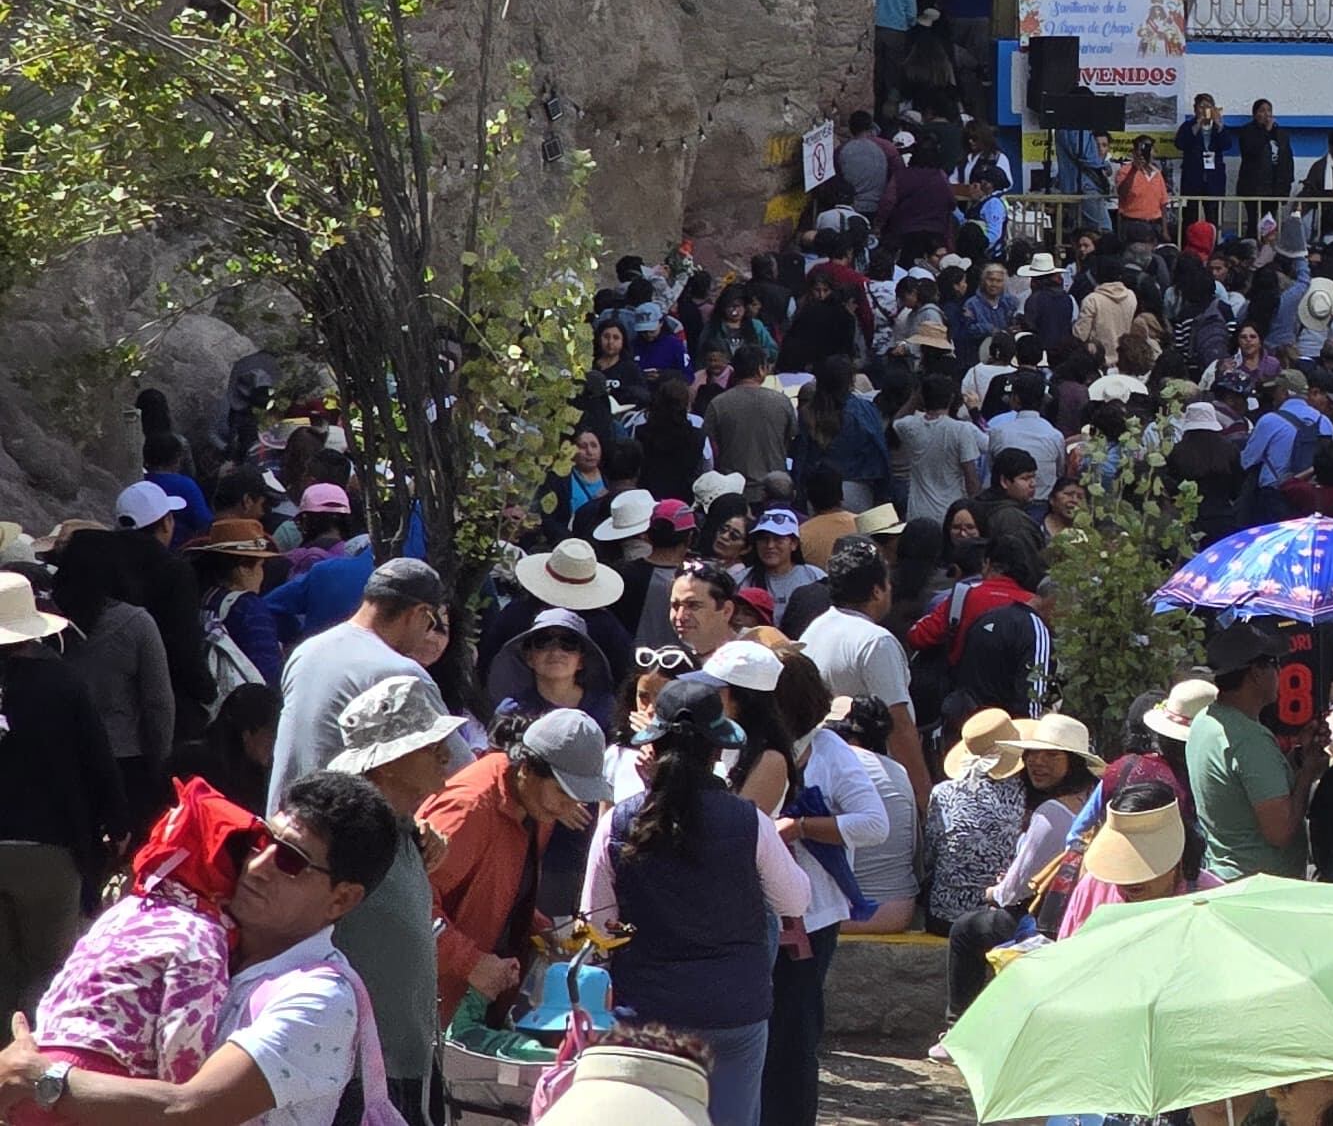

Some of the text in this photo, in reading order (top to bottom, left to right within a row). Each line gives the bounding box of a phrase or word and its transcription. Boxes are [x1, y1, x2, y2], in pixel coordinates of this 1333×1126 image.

[1051, 0, 1127, 16] Santuario de la
[1044, 20, 1134, 37] Virgen de Chapi
[1079, 67, 1177, 85] VENIDOS
